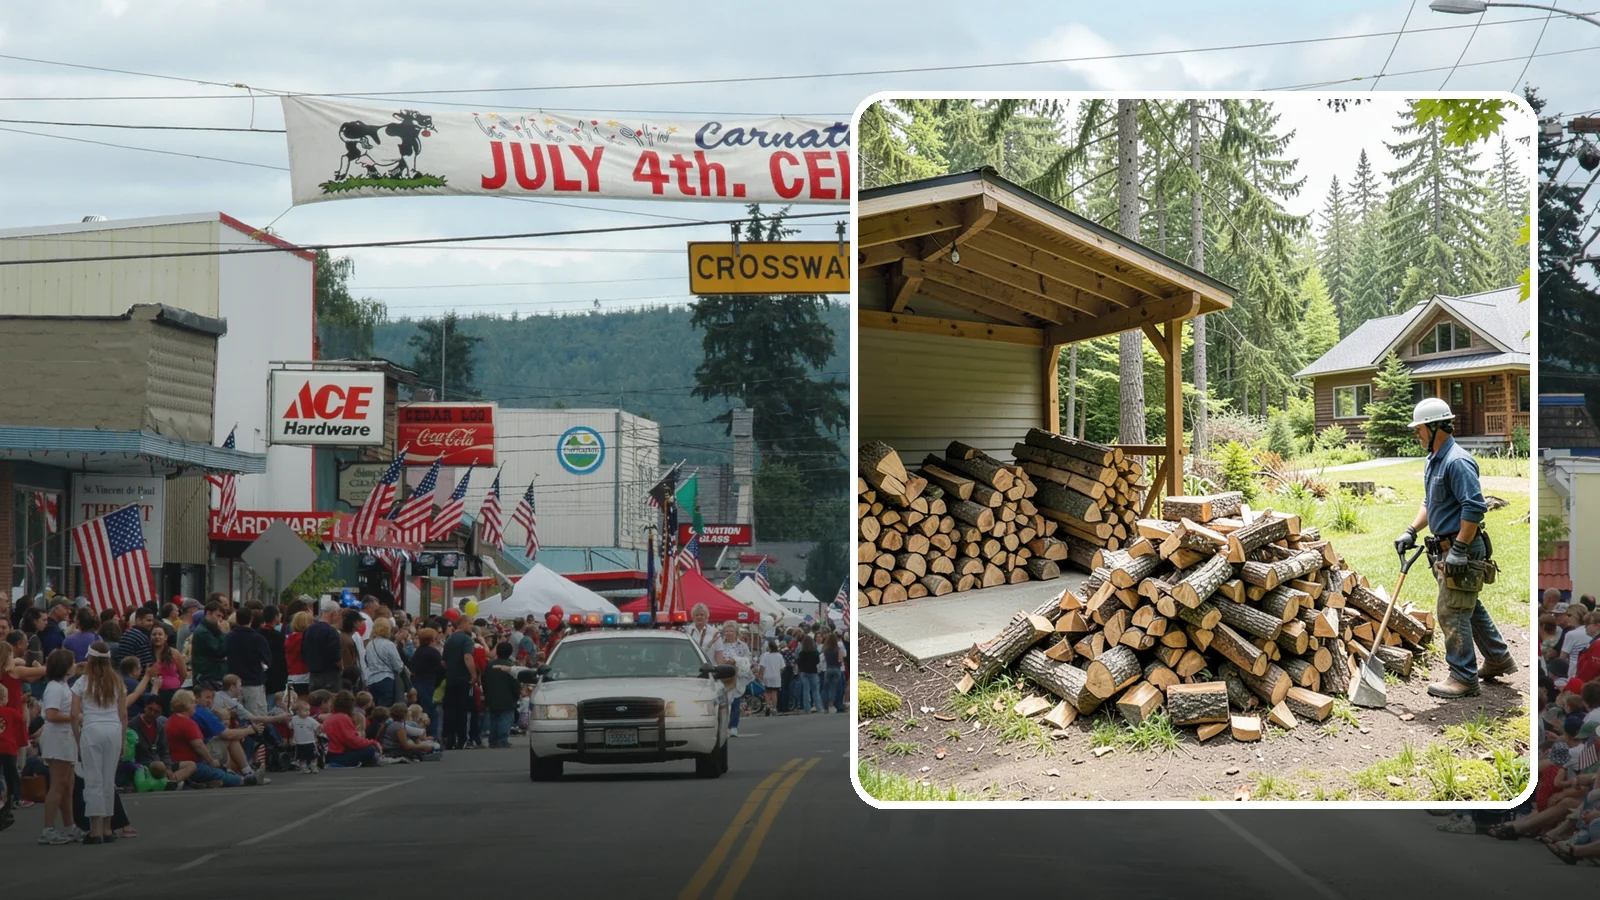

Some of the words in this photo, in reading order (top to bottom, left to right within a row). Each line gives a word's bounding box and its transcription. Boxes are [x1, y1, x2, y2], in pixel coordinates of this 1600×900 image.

[481, 141, 604, 193] JULY
[632, 150, 746, 198] 4th.
[697, 254, 850, 280] CROSSWA
[282, 380, 374, 421] ACE
[405, 409, 452, 422] CEDAR
[283, 421, 371, 437] Hardware
[416, 428, 477, 447] Coca-Cola
[353, 467, 385, 480] Simpl
[95, 485, 124, 495] Vincent
[126, 486, 136, 495] de
[138, 486, 155, 496] Paul
[212, 516, 330, 535] HARDARE
[688, 526, 741, 535] CRNATION
[699, 535, 730, 543] GLASS
